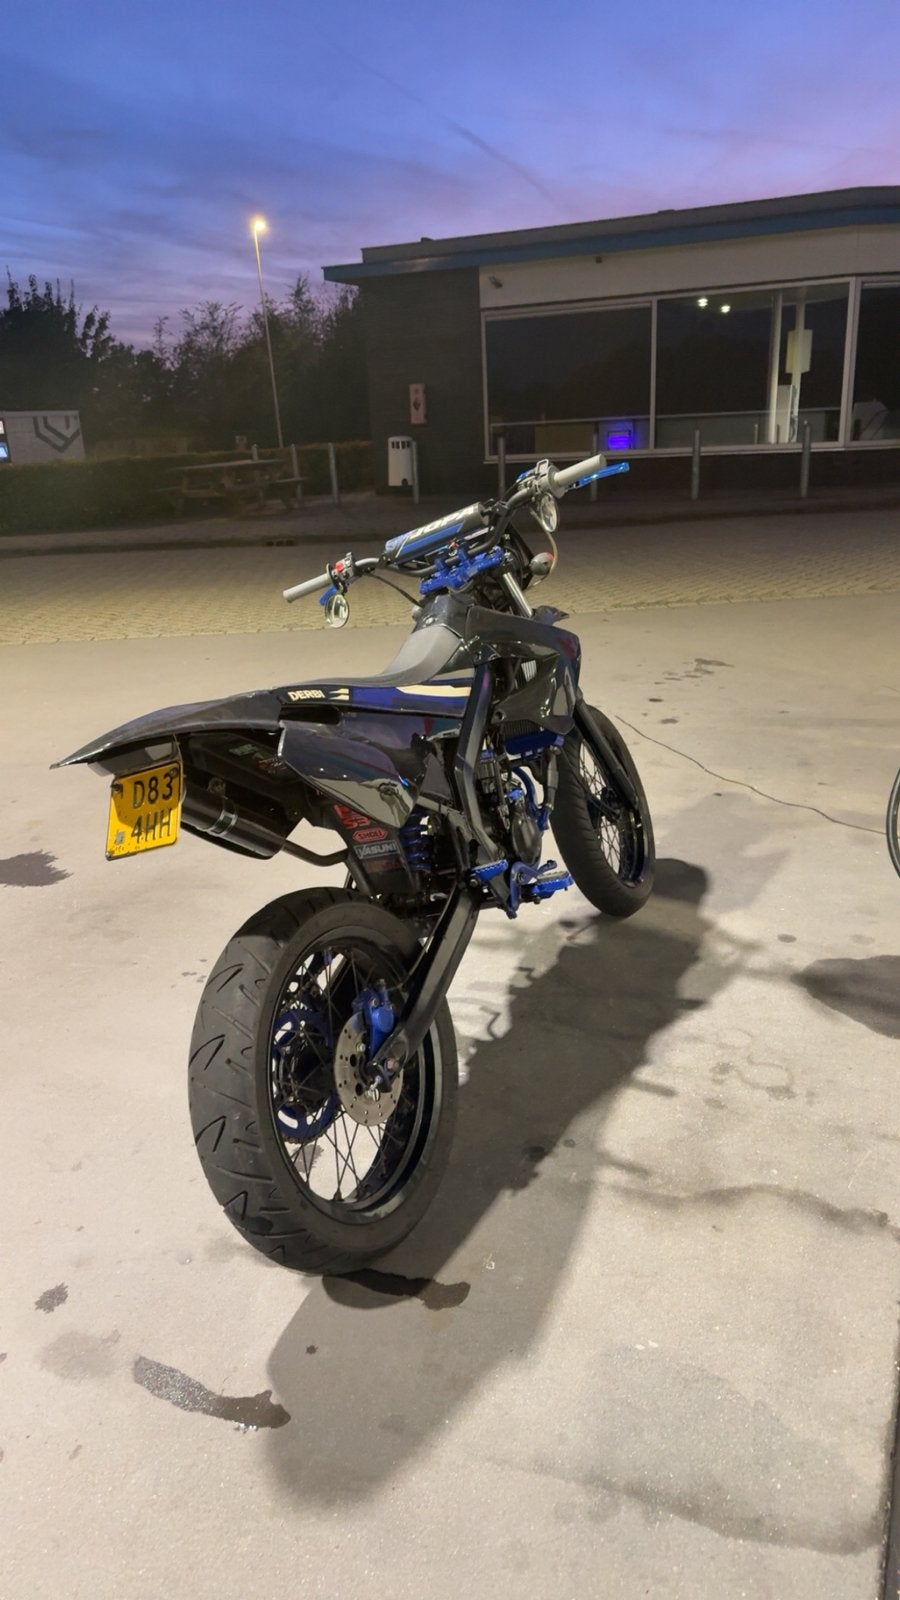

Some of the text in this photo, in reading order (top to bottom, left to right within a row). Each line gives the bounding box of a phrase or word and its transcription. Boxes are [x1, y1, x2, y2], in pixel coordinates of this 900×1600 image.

[287, 689, 326, 702] DERBI
[132, 772, 174, 809] D83
[131, 807, 173, 844] 4HH
